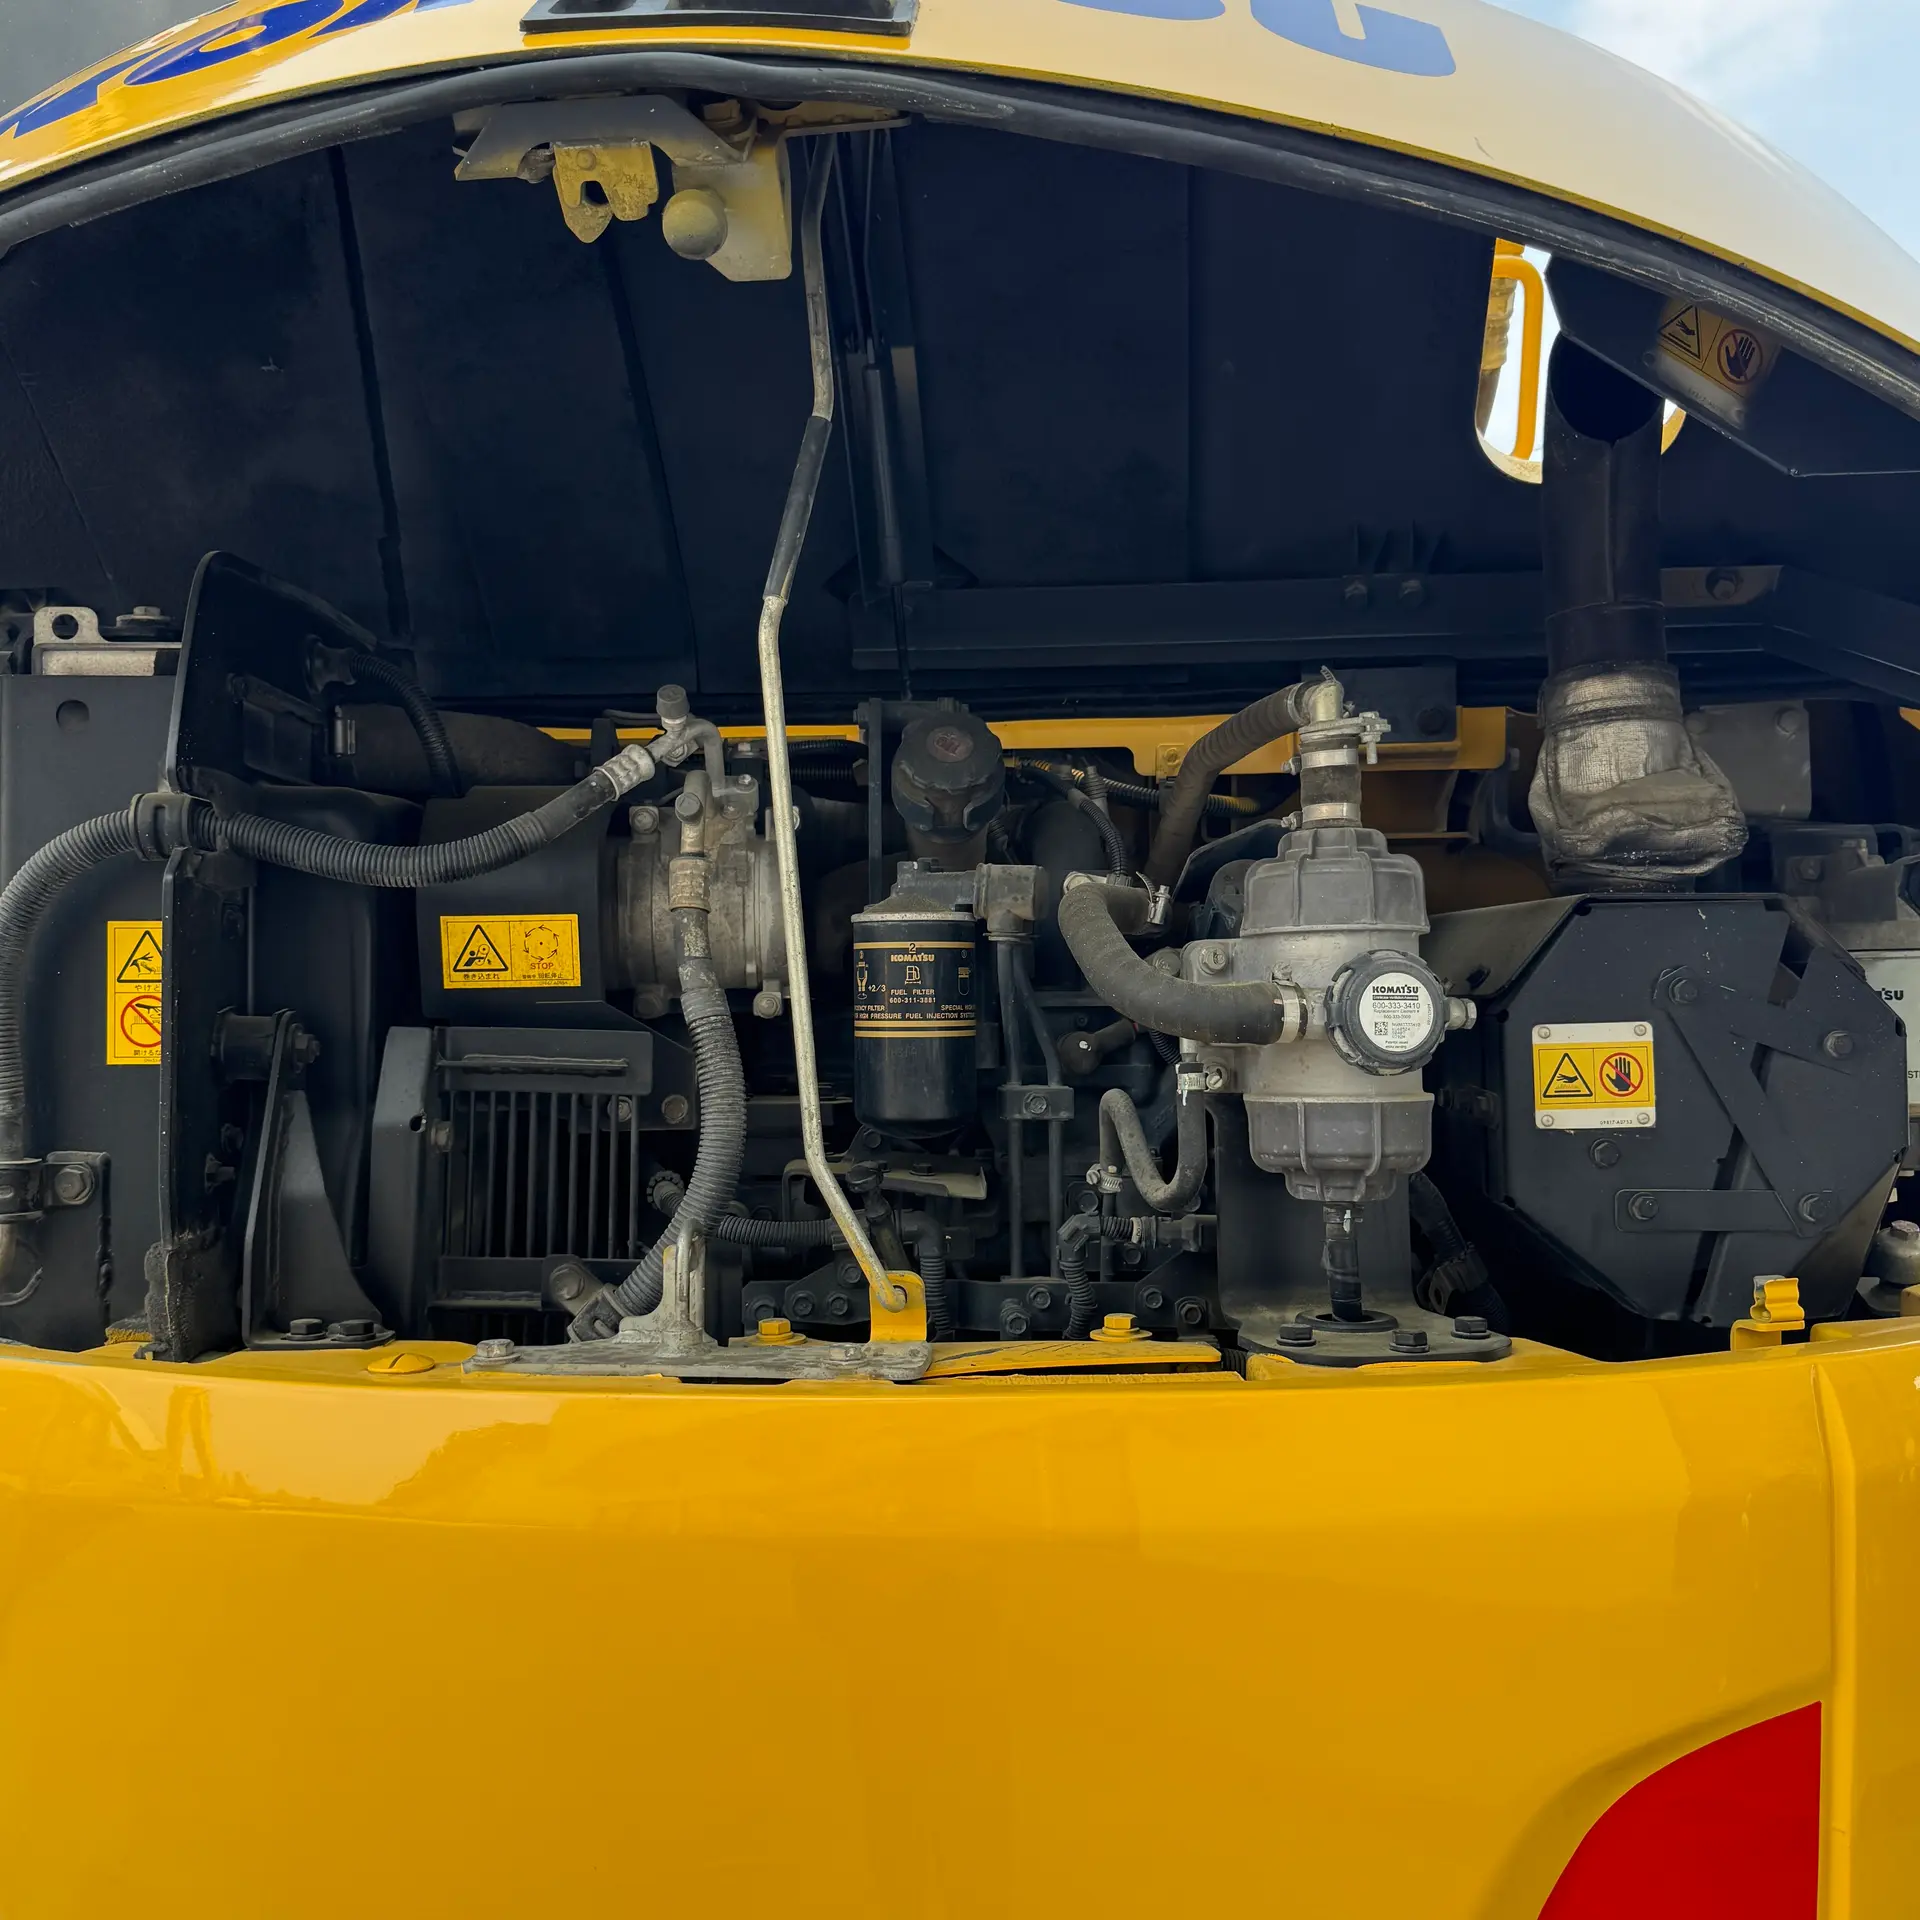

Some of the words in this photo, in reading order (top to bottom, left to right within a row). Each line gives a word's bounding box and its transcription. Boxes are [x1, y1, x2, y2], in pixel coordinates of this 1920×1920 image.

[890, 952, 935, 962] KOMATSU
[531, 962, 554, 970] STOP
[134, 984, 161, 992] やけど
[868, 984, 886, 992] +2/3
[1372, 984, 1418, 993] KOMATSU
